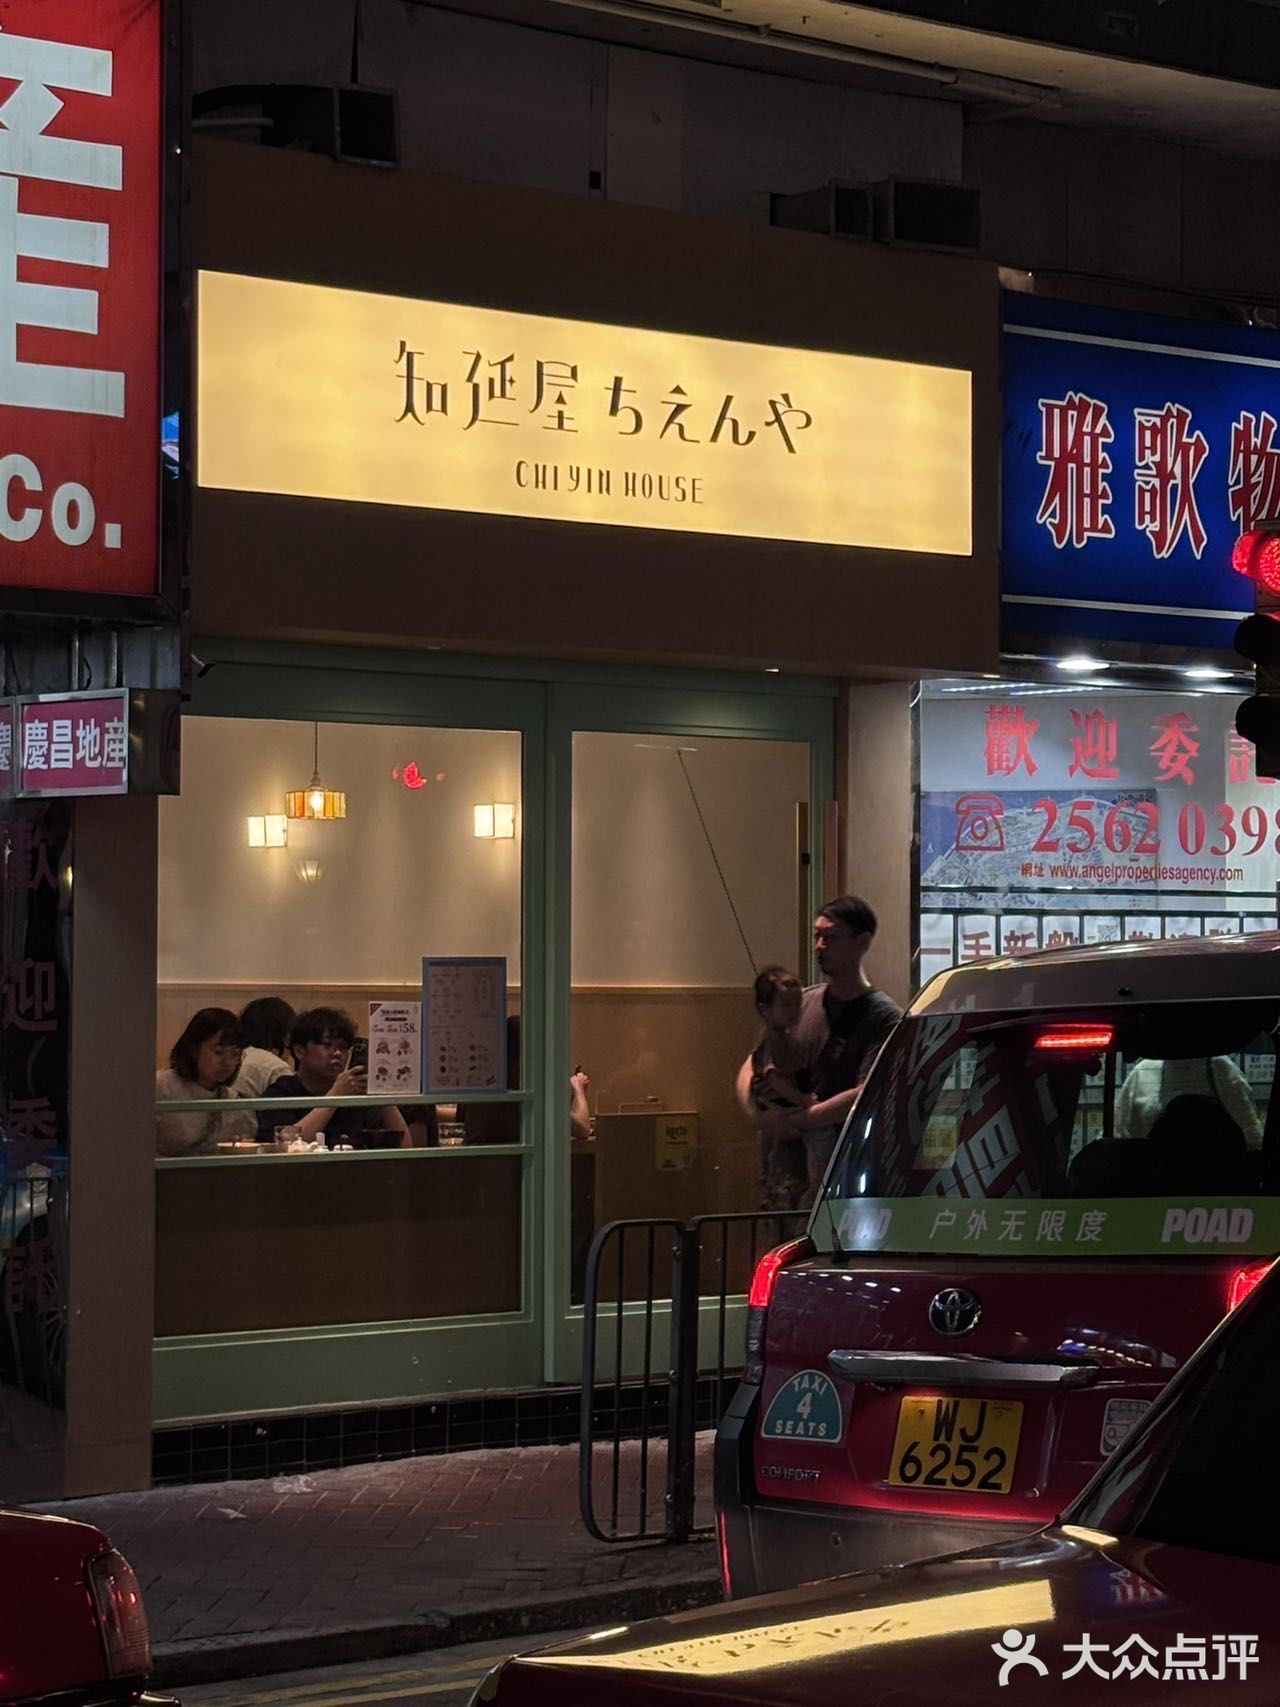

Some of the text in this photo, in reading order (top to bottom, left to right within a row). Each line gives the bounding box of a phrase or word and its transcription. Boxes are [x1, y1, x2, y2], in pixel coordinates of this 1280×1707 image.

[516, 460, 705, 504] CHIYIN HOUSE
[0, 454, 122, 549] Co.
[1031, 798, 1280, 856] 2562 039
[1021, 863, 1243, 884] 網址 www.angelpropertiesagency.com
[929, 1209, 1107, 1243] 户外无限度
[1161, 1208, 1255, 1244] POAD
[793, 1374, 828, 1397] TAXI
[797, 1392, 814, 1419] 4
[933, 1399, 988, 1443] WJ
[775, 1420, 827, 1437] SEATS
[899, 1441, 1007, 1489] 6252
